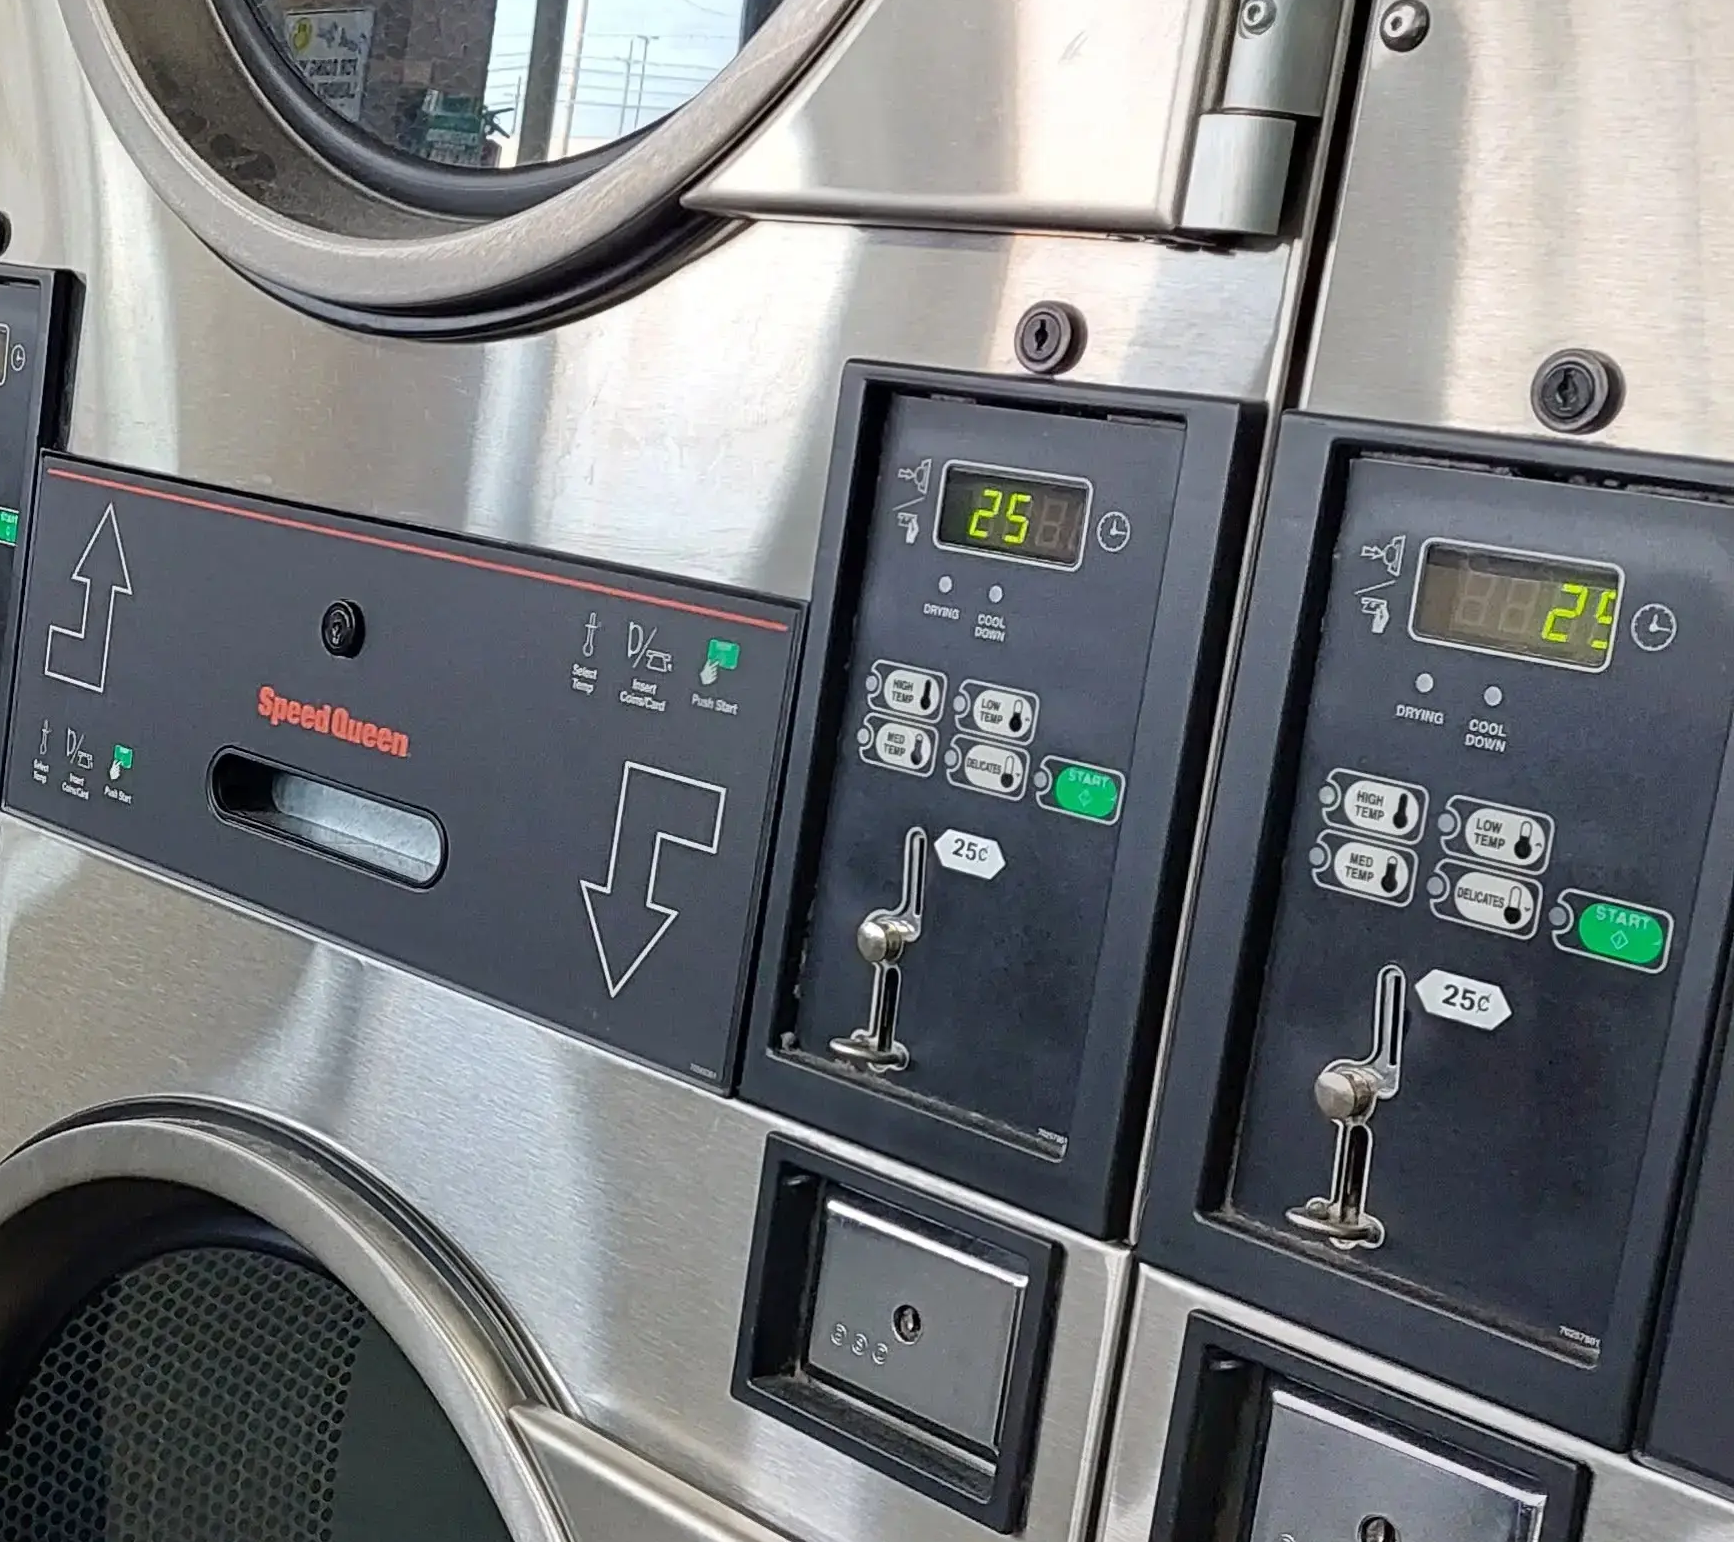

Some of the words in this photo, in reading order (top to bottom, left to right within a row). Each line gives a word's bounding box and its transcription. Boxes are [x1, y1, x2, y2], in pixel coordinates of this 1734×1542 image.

[968, 488, 1033, 545] 25
[922, 602, 961, 621] DRYING
[977, 613, 1007, 630] COOL
[974, 626, 1007, 643] DOWN
[571, 677, 595, 695] Temp
[631, 678, 657, 696] Insert
[892, 677, 914, 692] HIGH
[691, 692, 715, 710] Push
[715, 698, 740, 716] Start
[891, 689, 915, 705] TEMP
[980, 696, 1002, 712] LOW
[257, 686, 332, 734] Speed
[331, 707, 410, 758] Queen
[979, 709, 1004, 725] TEMP
[1395, 704, 1445, 726] DRYING
[886, 730, 906, 745] MED
[1469, 718, 1507, 738] COOL
[883, 742, 907, 758] TEMP
[1465, 733, 1507, 753] DOWN
[966, 756, 1003, 776] DELICATES
[1067, 766, 1112, 789] START
[1356, 789, 1385, 808] HIGH
[1354, 803, 1386, 822] TEMP
[1475, 816, 1504, 835] LOW
[952, 837, 990, 864] 25¢
[1473, 831, 1506, 851] TEMP
[1349, 852, 1374, 869] MED
[1345, 864, 1375, 883] TEMP
[1456, 885, 1506, 911] DELICATES
[1595, 906, 1652, 932] START
[1441, 983, 1493, 1015] 25¢
